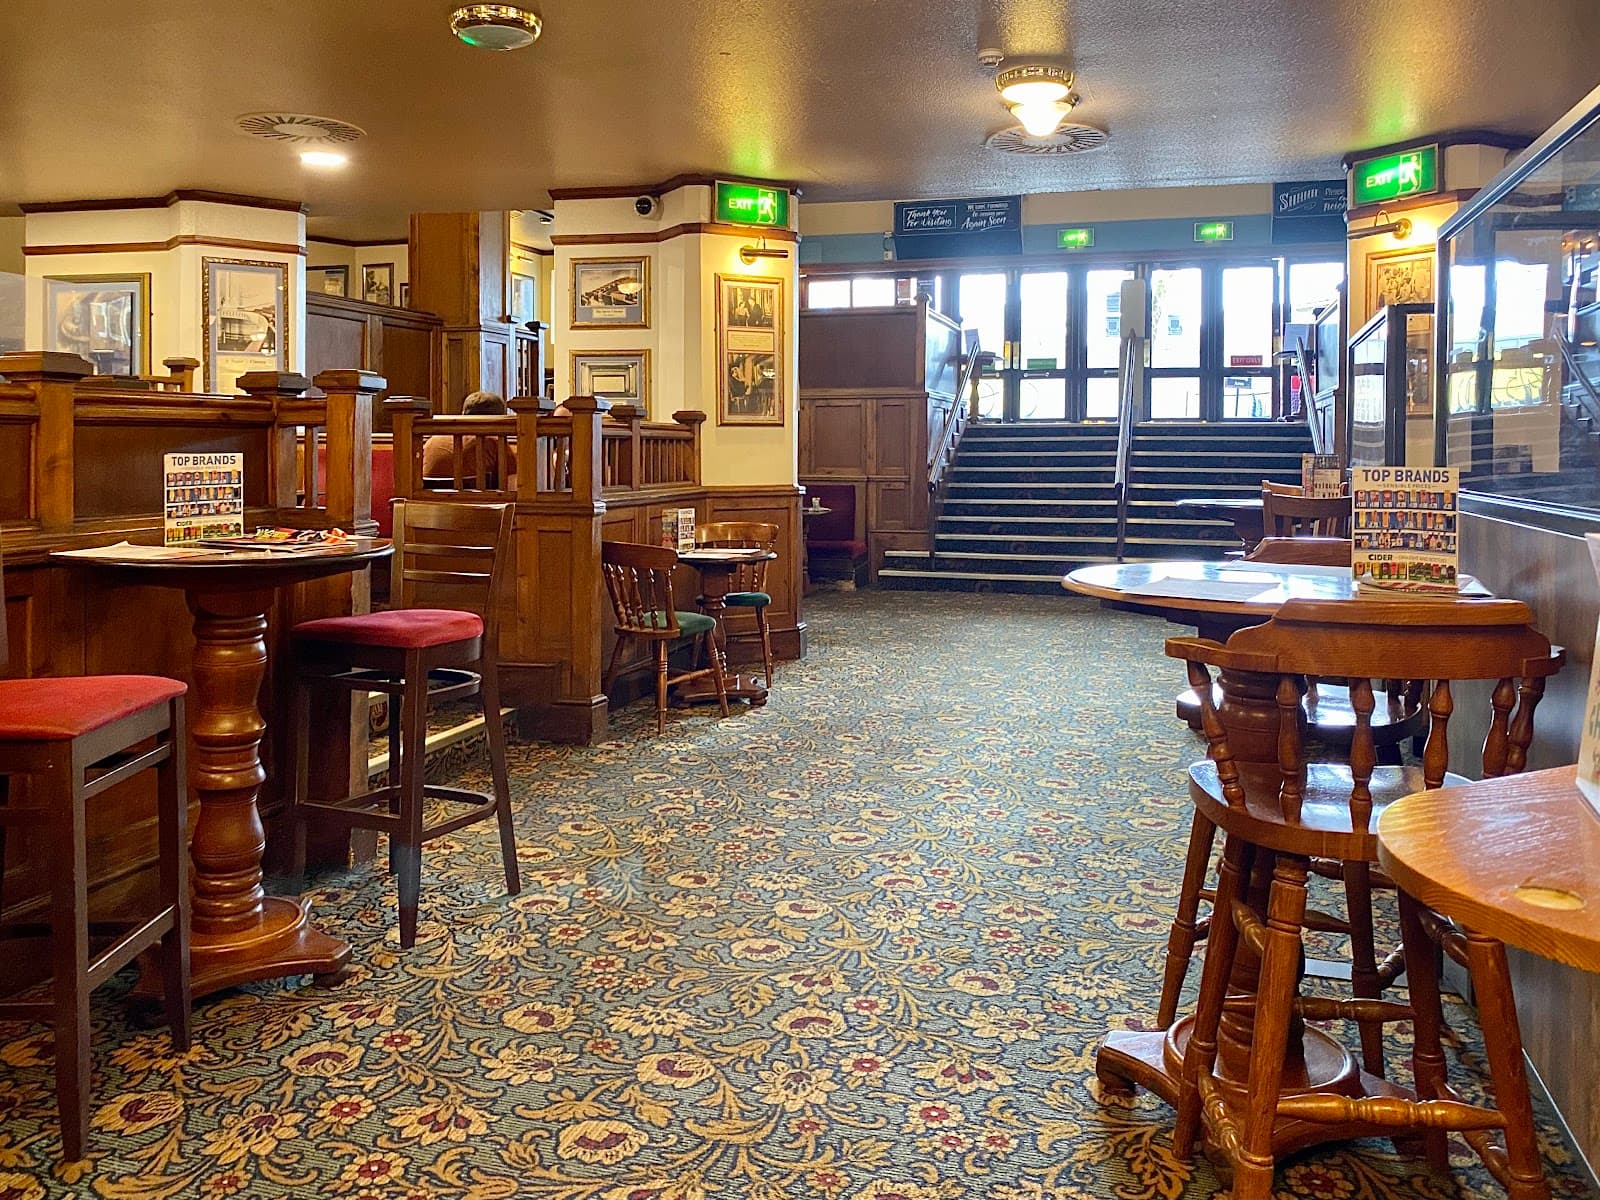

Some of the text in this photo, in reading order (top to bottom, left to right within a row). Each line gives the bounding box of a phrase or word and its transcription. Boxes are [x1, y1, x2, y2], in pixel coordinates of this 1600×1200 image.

[1366, 170, 1394, 188] EXIT
[728, 198, 753, 210] EXIT
[907, 209, 930, 220] Thank
[921, 216, 952, 227] Visiting
[960, 215, 1006, 231] Again Soon
[171, 455, 236, 466] TOP BRANDS
[1362, 469, 1450, 483] TOP BRANDS
